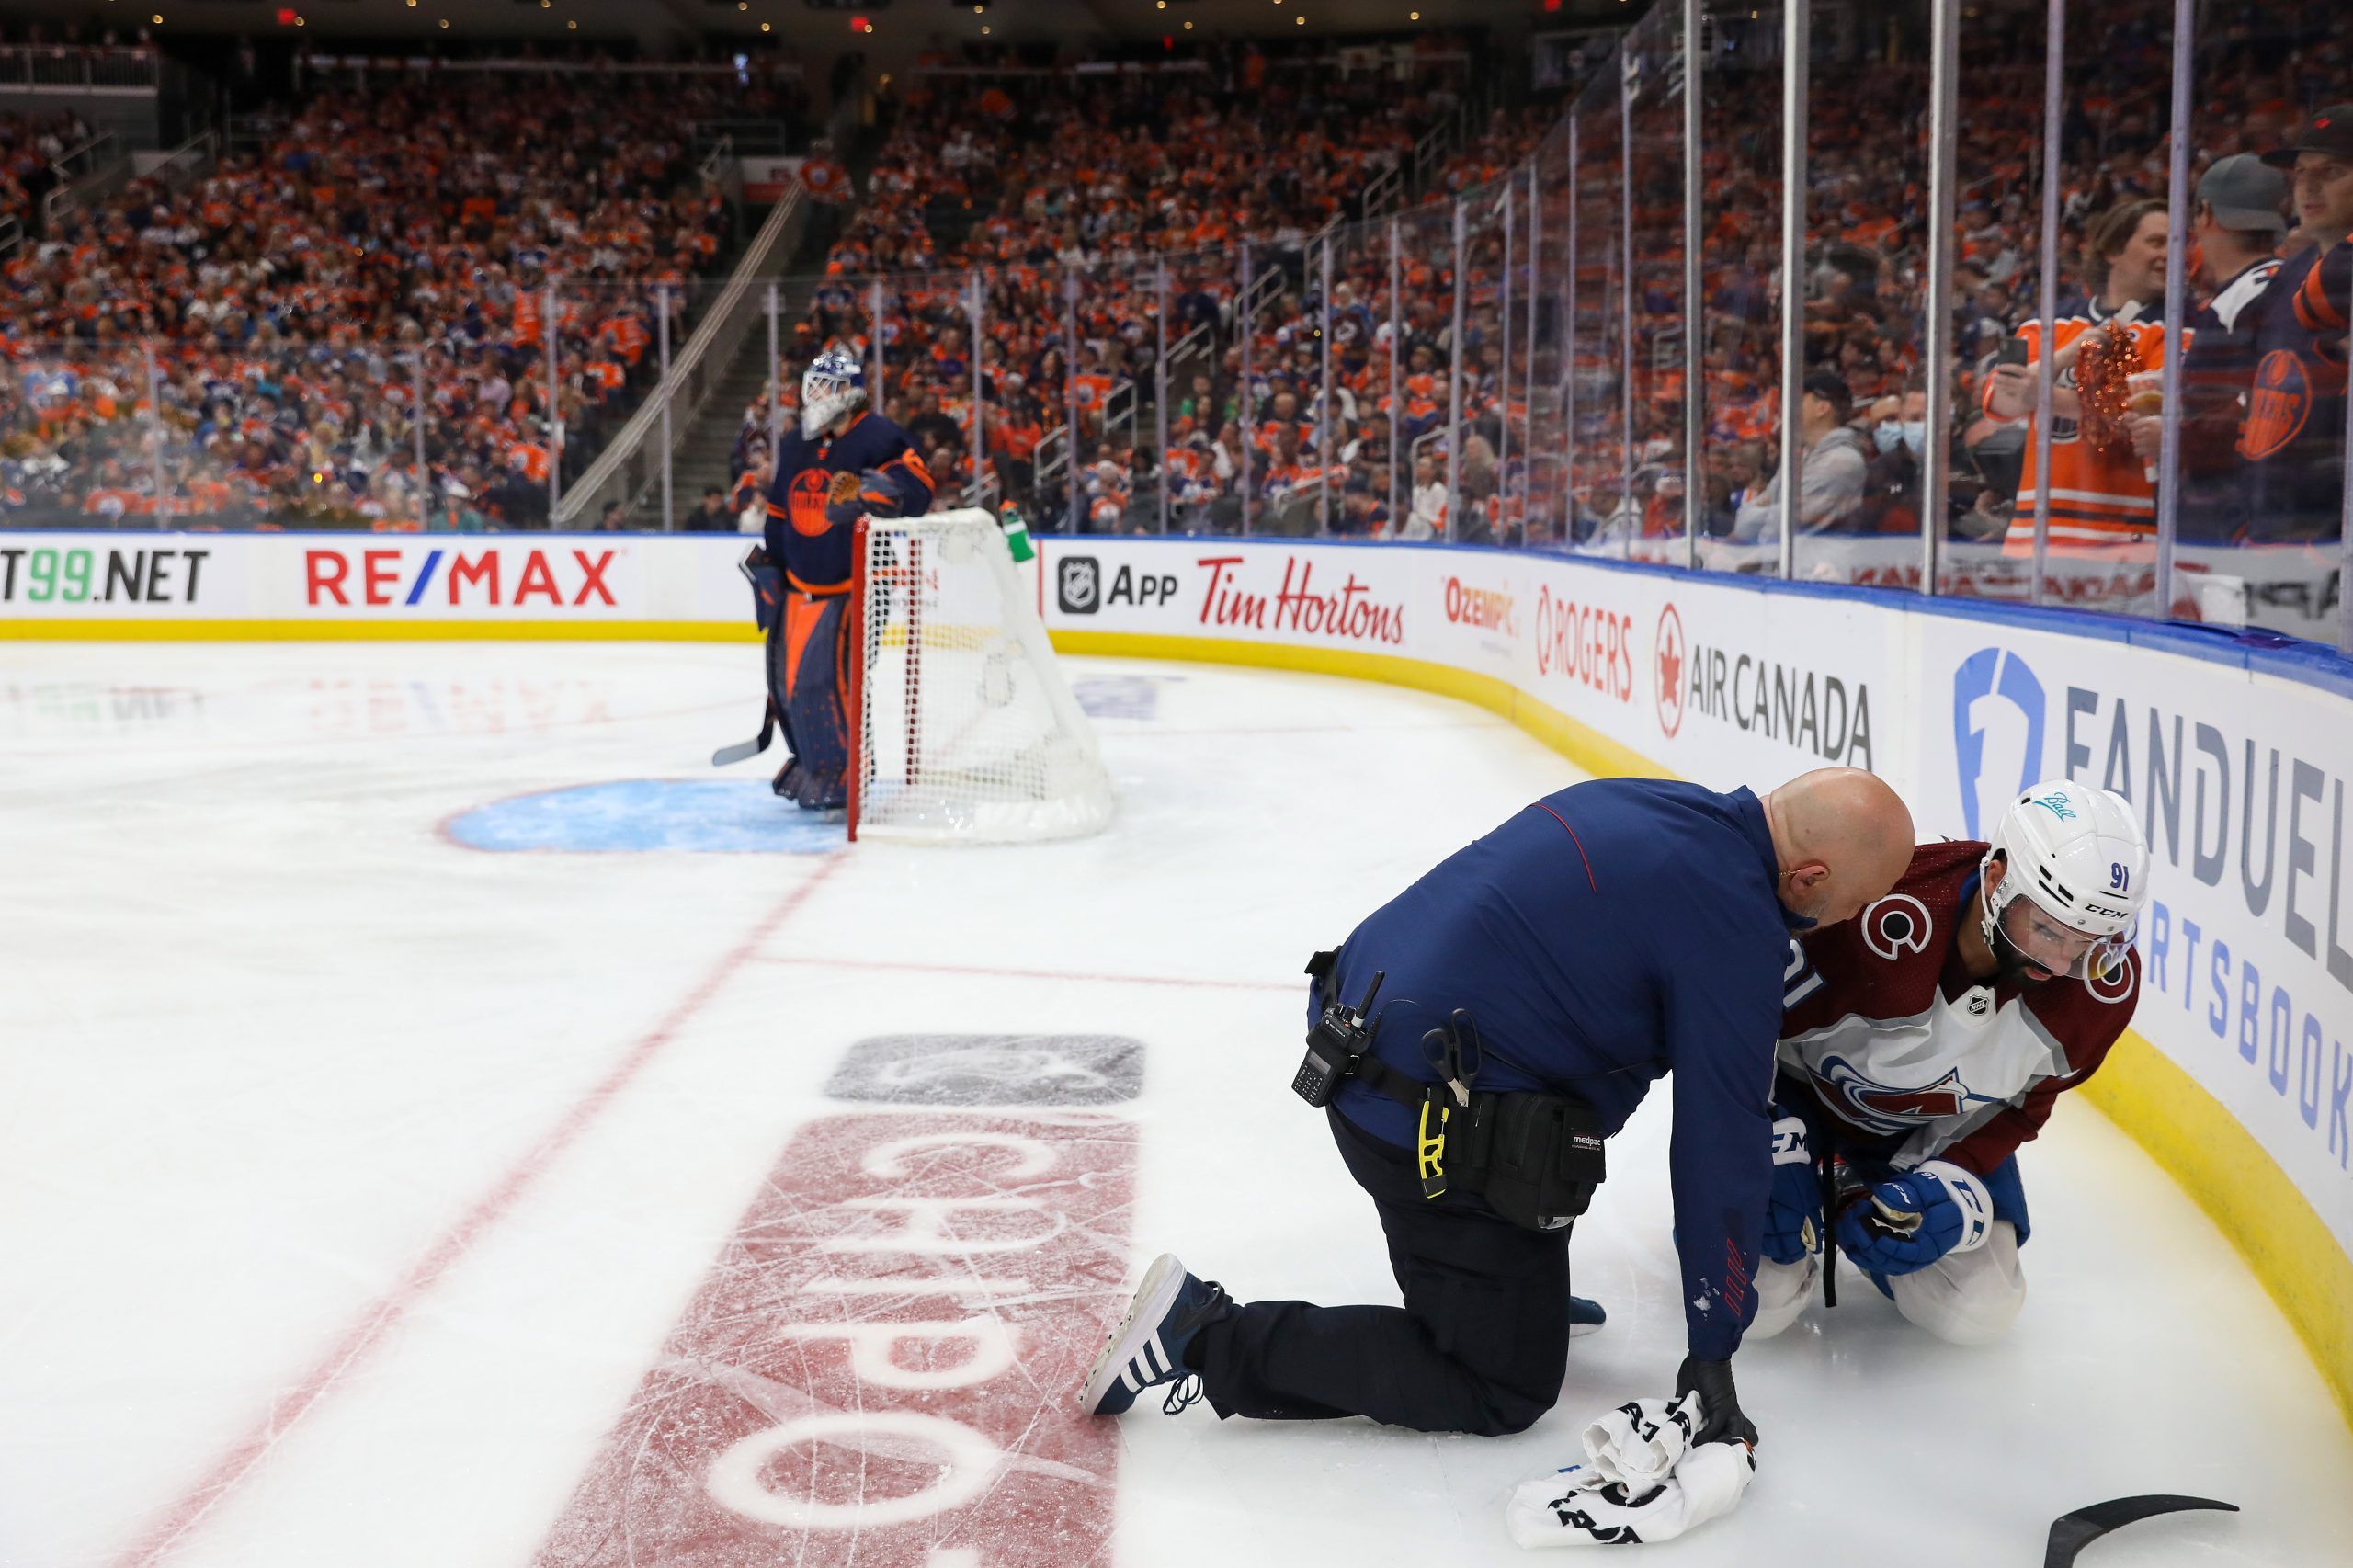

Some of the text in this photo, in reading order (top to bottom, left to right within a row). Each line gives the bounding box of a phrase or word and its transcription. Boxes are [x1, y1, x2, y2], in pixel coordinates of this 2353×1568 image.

[305, 550, 619, 607] RE/MAX
[1197, 556, 1404, 644] Tim Hortons
[1555, 598, 1632, 703] ROGERS
[1689, 644, 1873, 774] AIR CANADA
[2033, 791, 2077, 823] Ball
[2064, 685, 2353, 995] FANDUEL
[2085, 903, 2129, 919] CCM
[2109, 862, 2130, 892] 91
[2132, 899, 2353, 1171] RTSBOOK
[710, 1132, 1071, 1568] CHIPO
